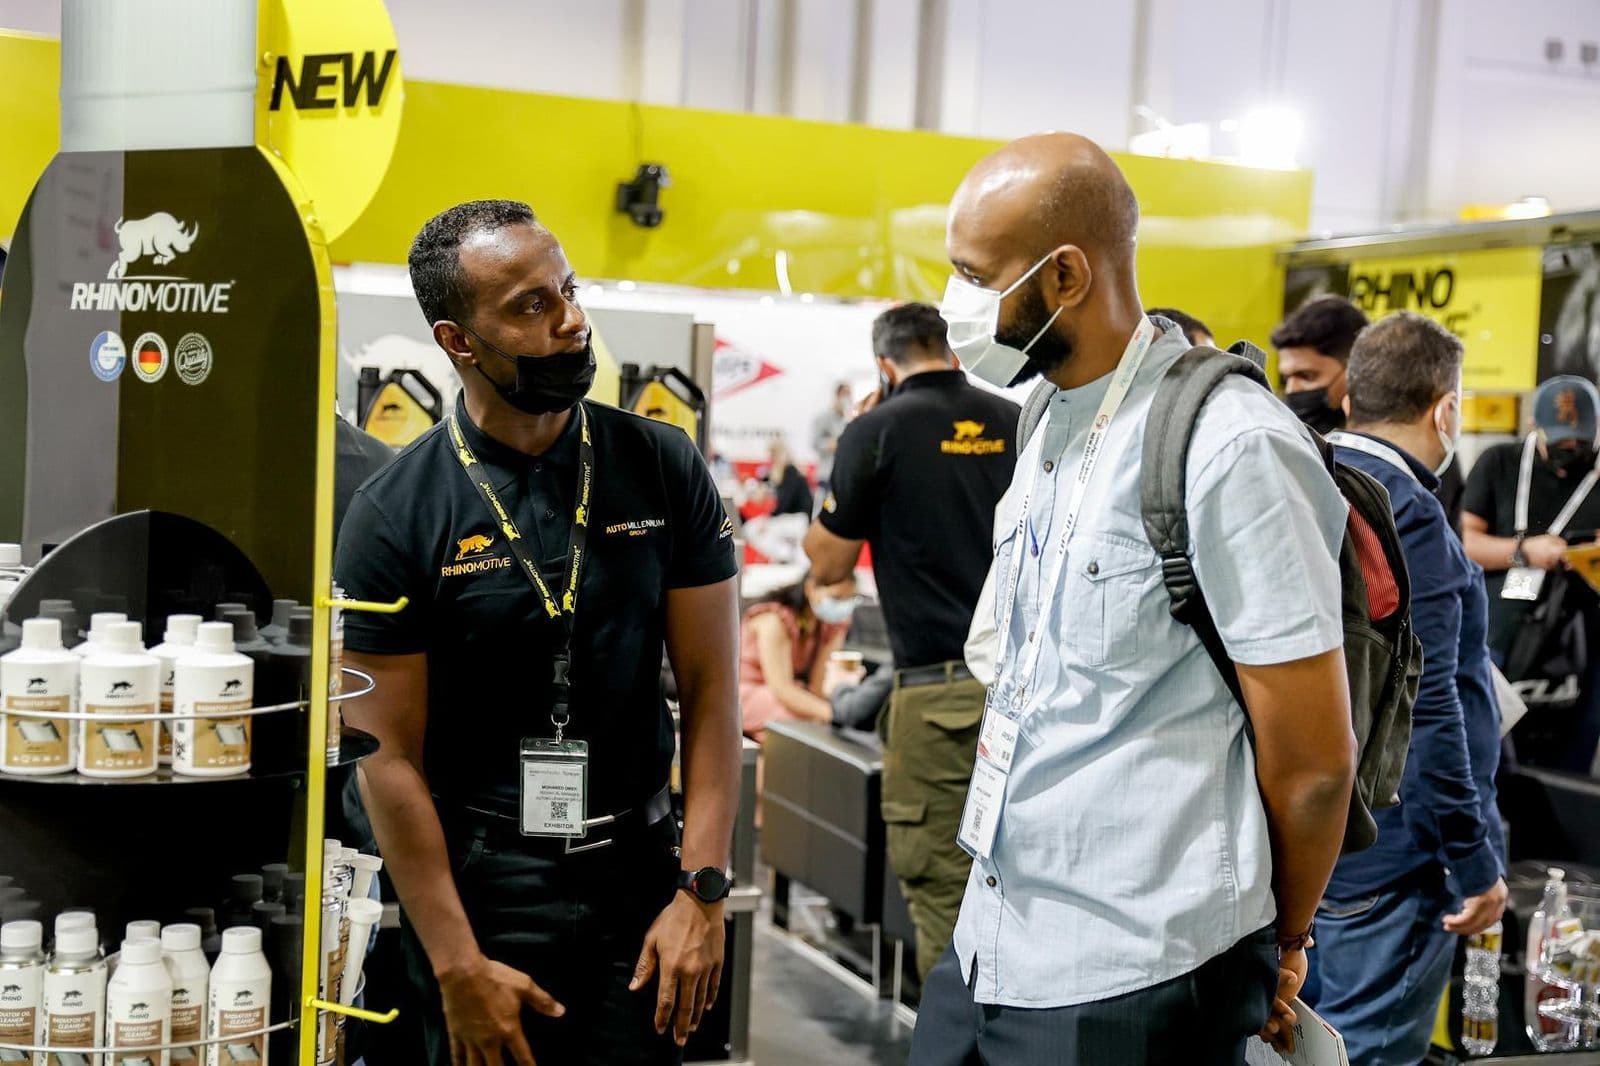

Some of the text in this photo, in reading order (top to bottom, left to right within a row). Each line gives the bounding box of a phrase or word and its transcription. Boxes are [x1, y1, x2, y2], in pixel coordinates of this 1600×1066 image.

[268, 50, 397, 112] NEW
[70, 282, 230, 313] RHINOMOTIVE
[1352, 268, 1454, 311] RHINO
[441, 557, 511, 577] RHINOMOTIVE
